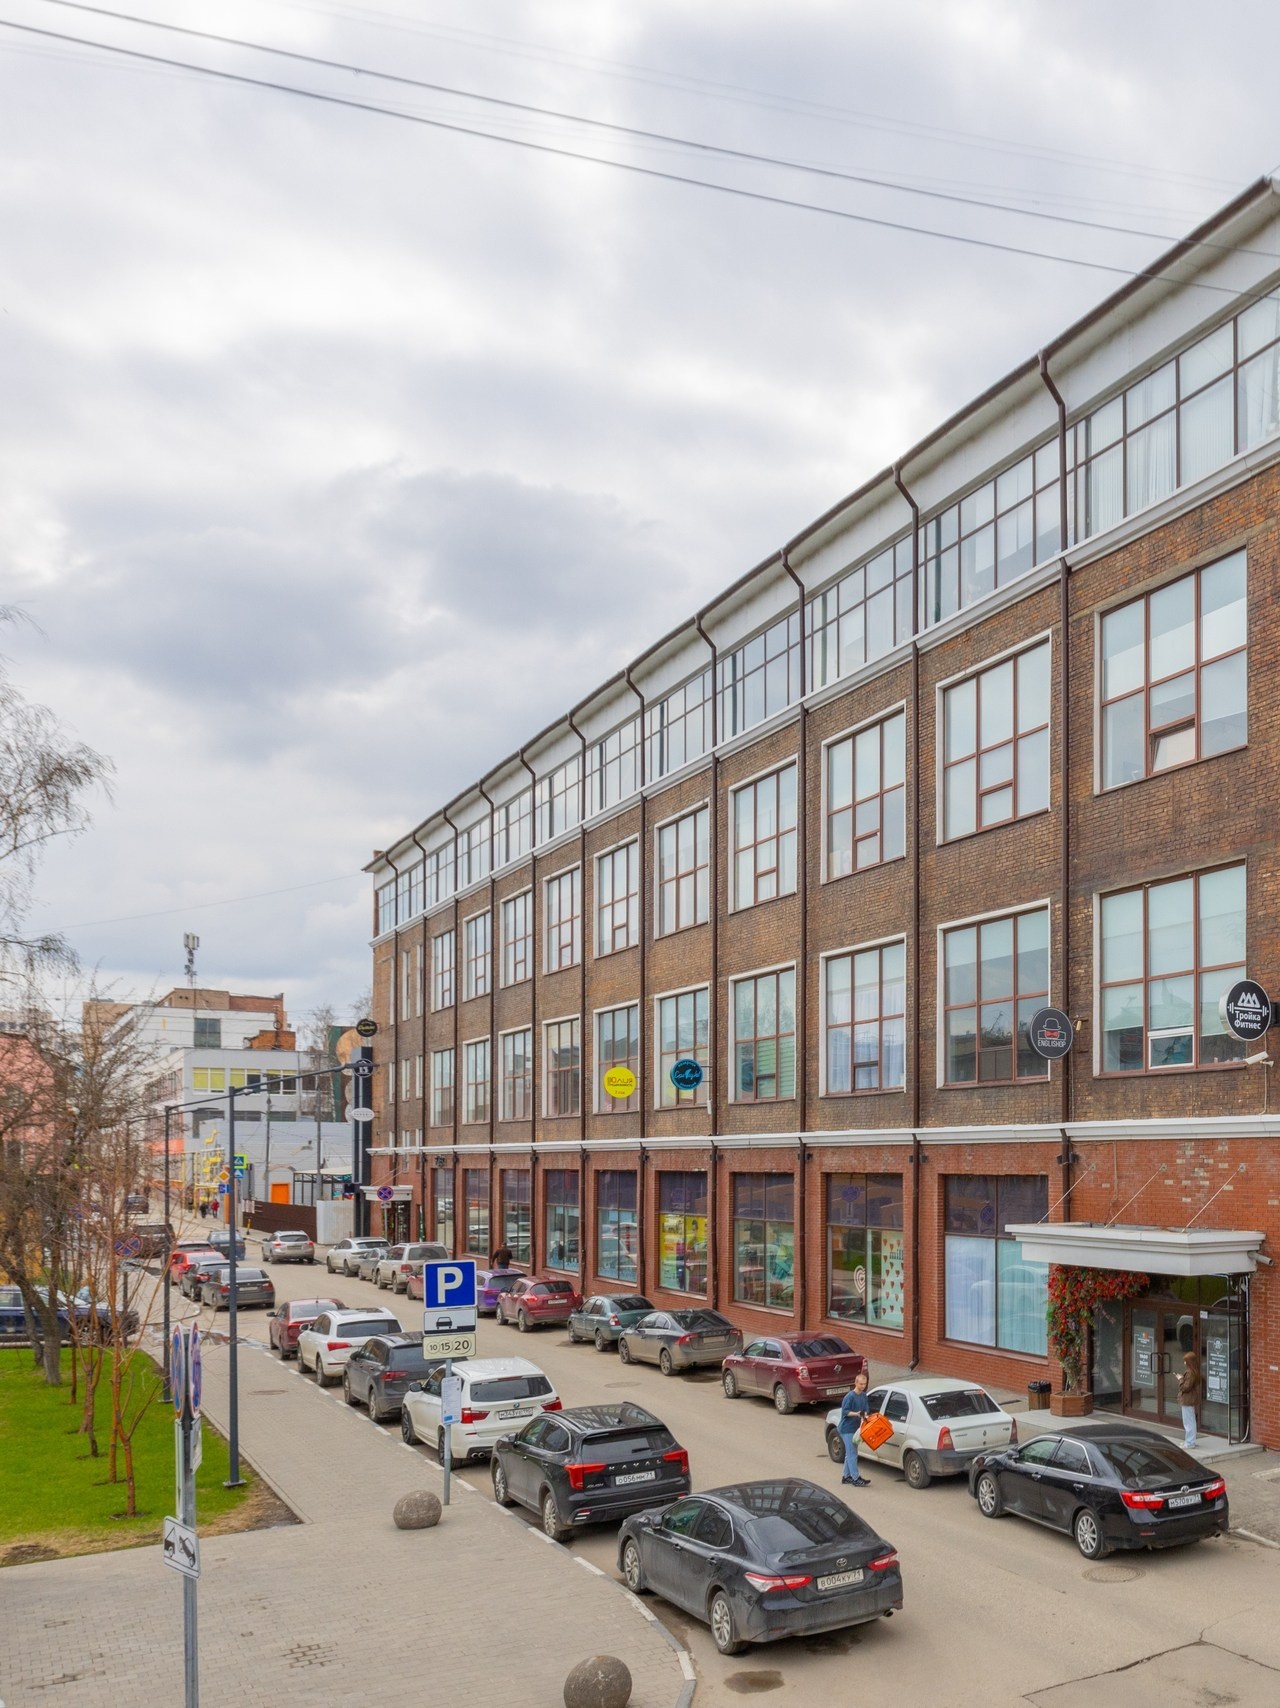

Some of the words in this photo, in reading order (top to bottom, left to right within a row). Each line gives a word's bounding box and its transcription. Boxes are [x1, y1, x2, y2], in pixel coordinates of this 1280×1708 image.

[1235, 1011, 1261, 1021] Тройка
[1234, 1019, 1262, 1030] Фитнес
[1037, 1039, 1067, 1048] ENGLISHOP
[437, 1266, 464, 1304] P
[441, 1342, 451, 1351] 15
[454, 1340, 470, 1351] 20
[609, 1459, 662, 1470] HAVAL
